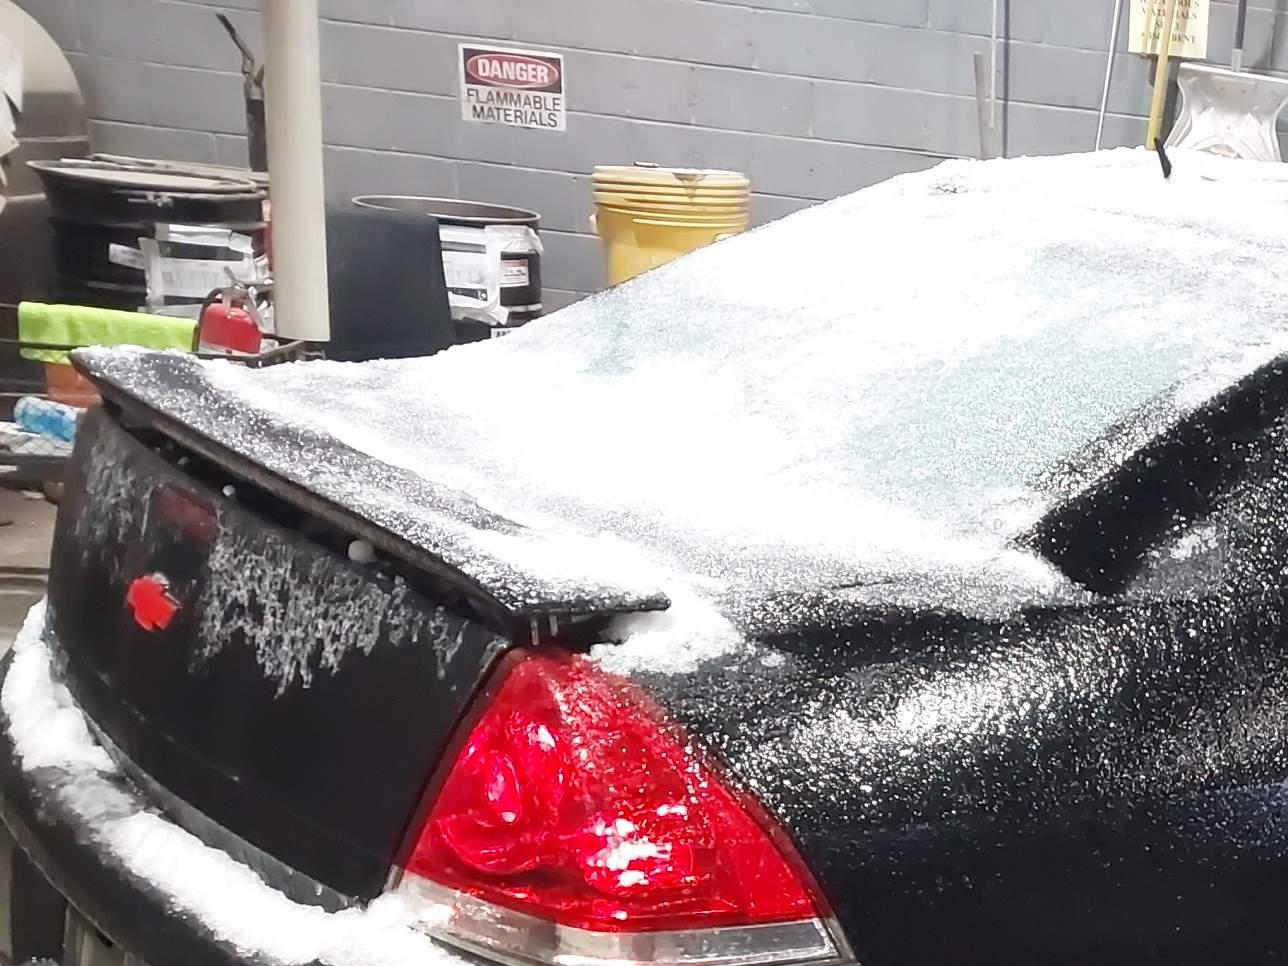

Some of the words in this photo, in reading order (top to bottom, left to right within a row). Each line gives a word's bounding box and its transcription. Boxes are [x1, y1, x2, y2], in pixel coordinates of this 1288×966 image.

[477, 58, 549, 83] DANGER
[466, 88, 561, 113] FLAMMABLE
[472, 104, 558, 128] MATERIALS
